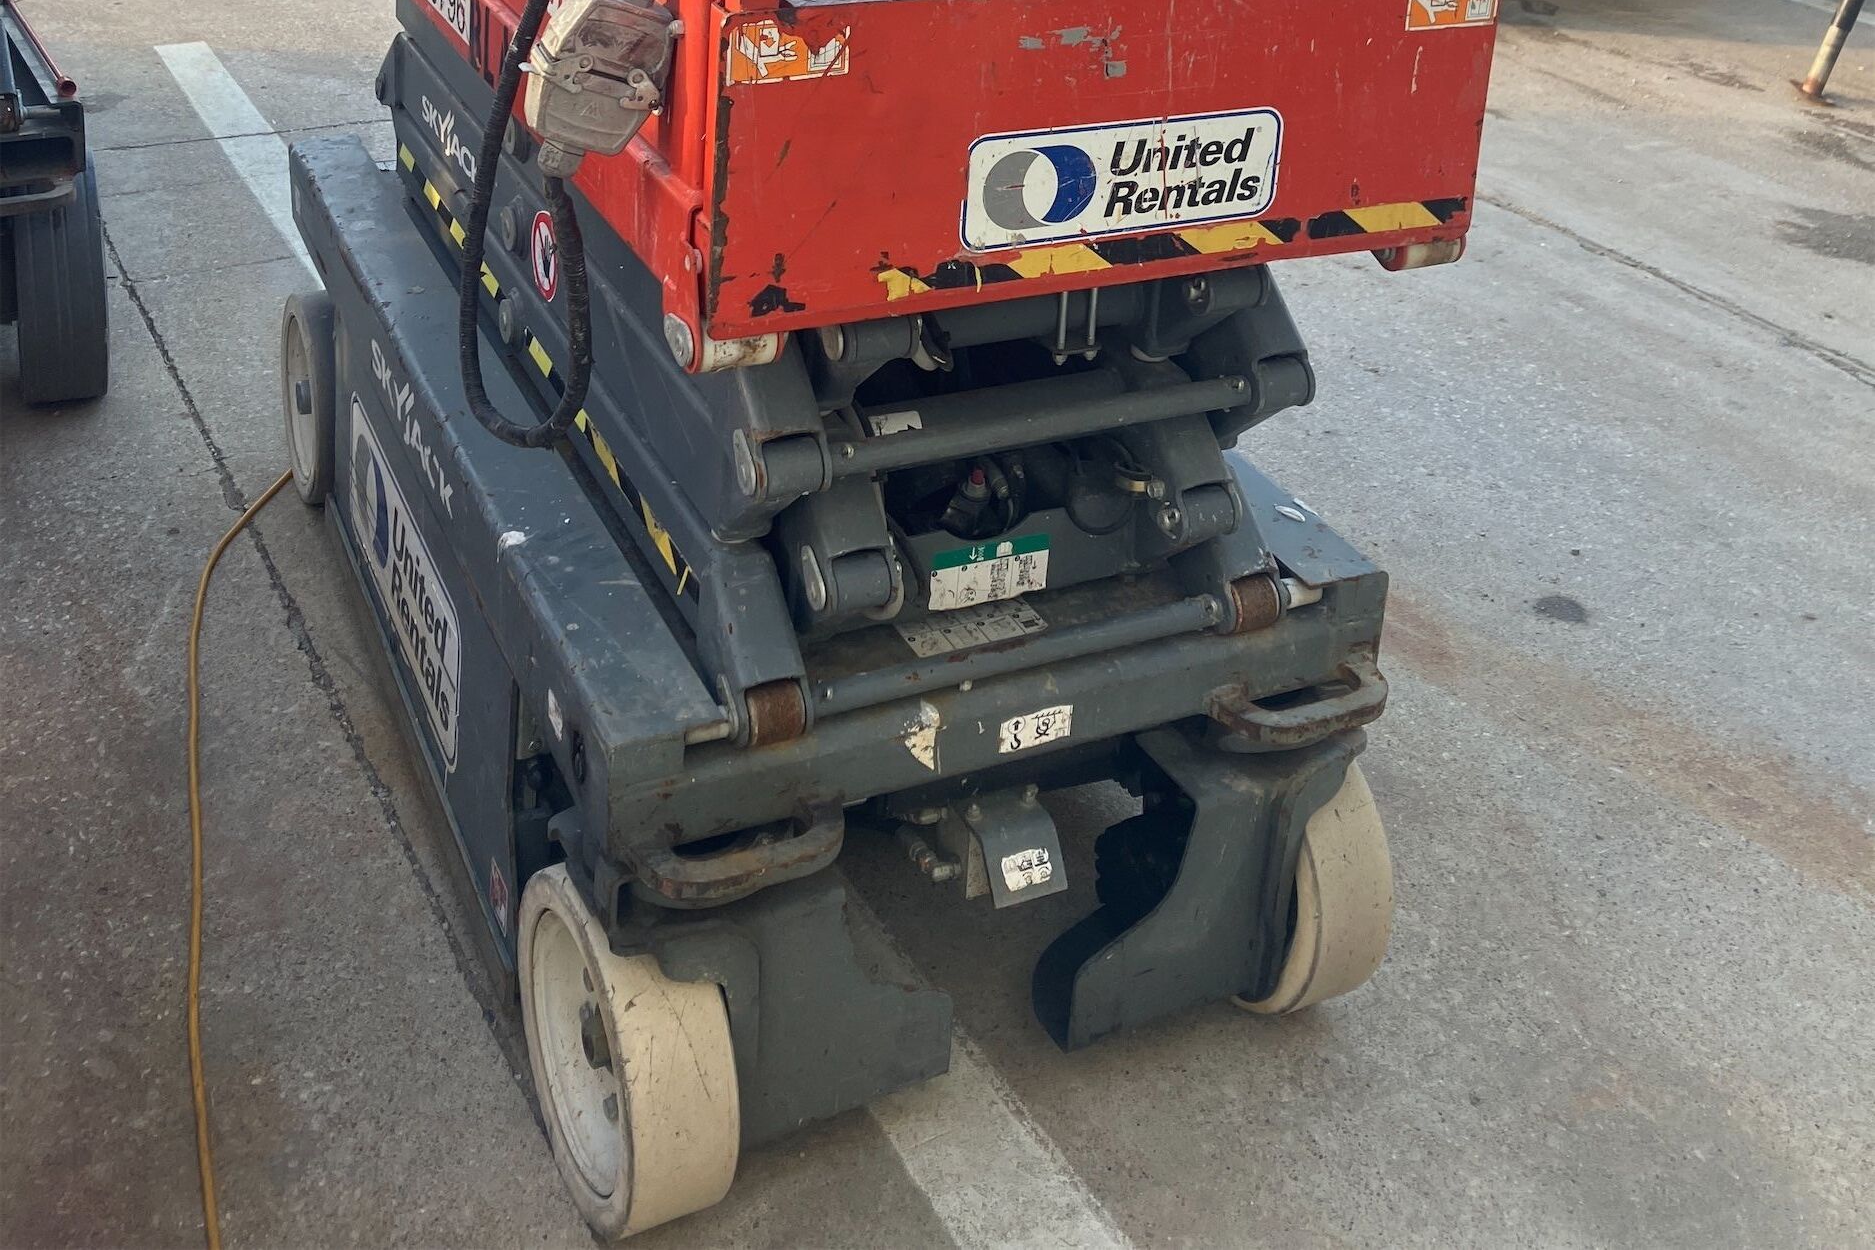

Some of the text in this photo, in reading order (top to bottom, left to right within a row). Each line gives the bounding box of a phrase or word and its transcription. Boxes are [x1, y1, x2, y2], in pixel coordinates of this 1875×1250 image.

[1104, 168, 1260, 218] Rentals
[1110, 128, 1255, 177] United
[371, 339, 454, 519] SKYJACK
[391, 560, 450, 732] Rentals
[393, 507, 448, 662] United
